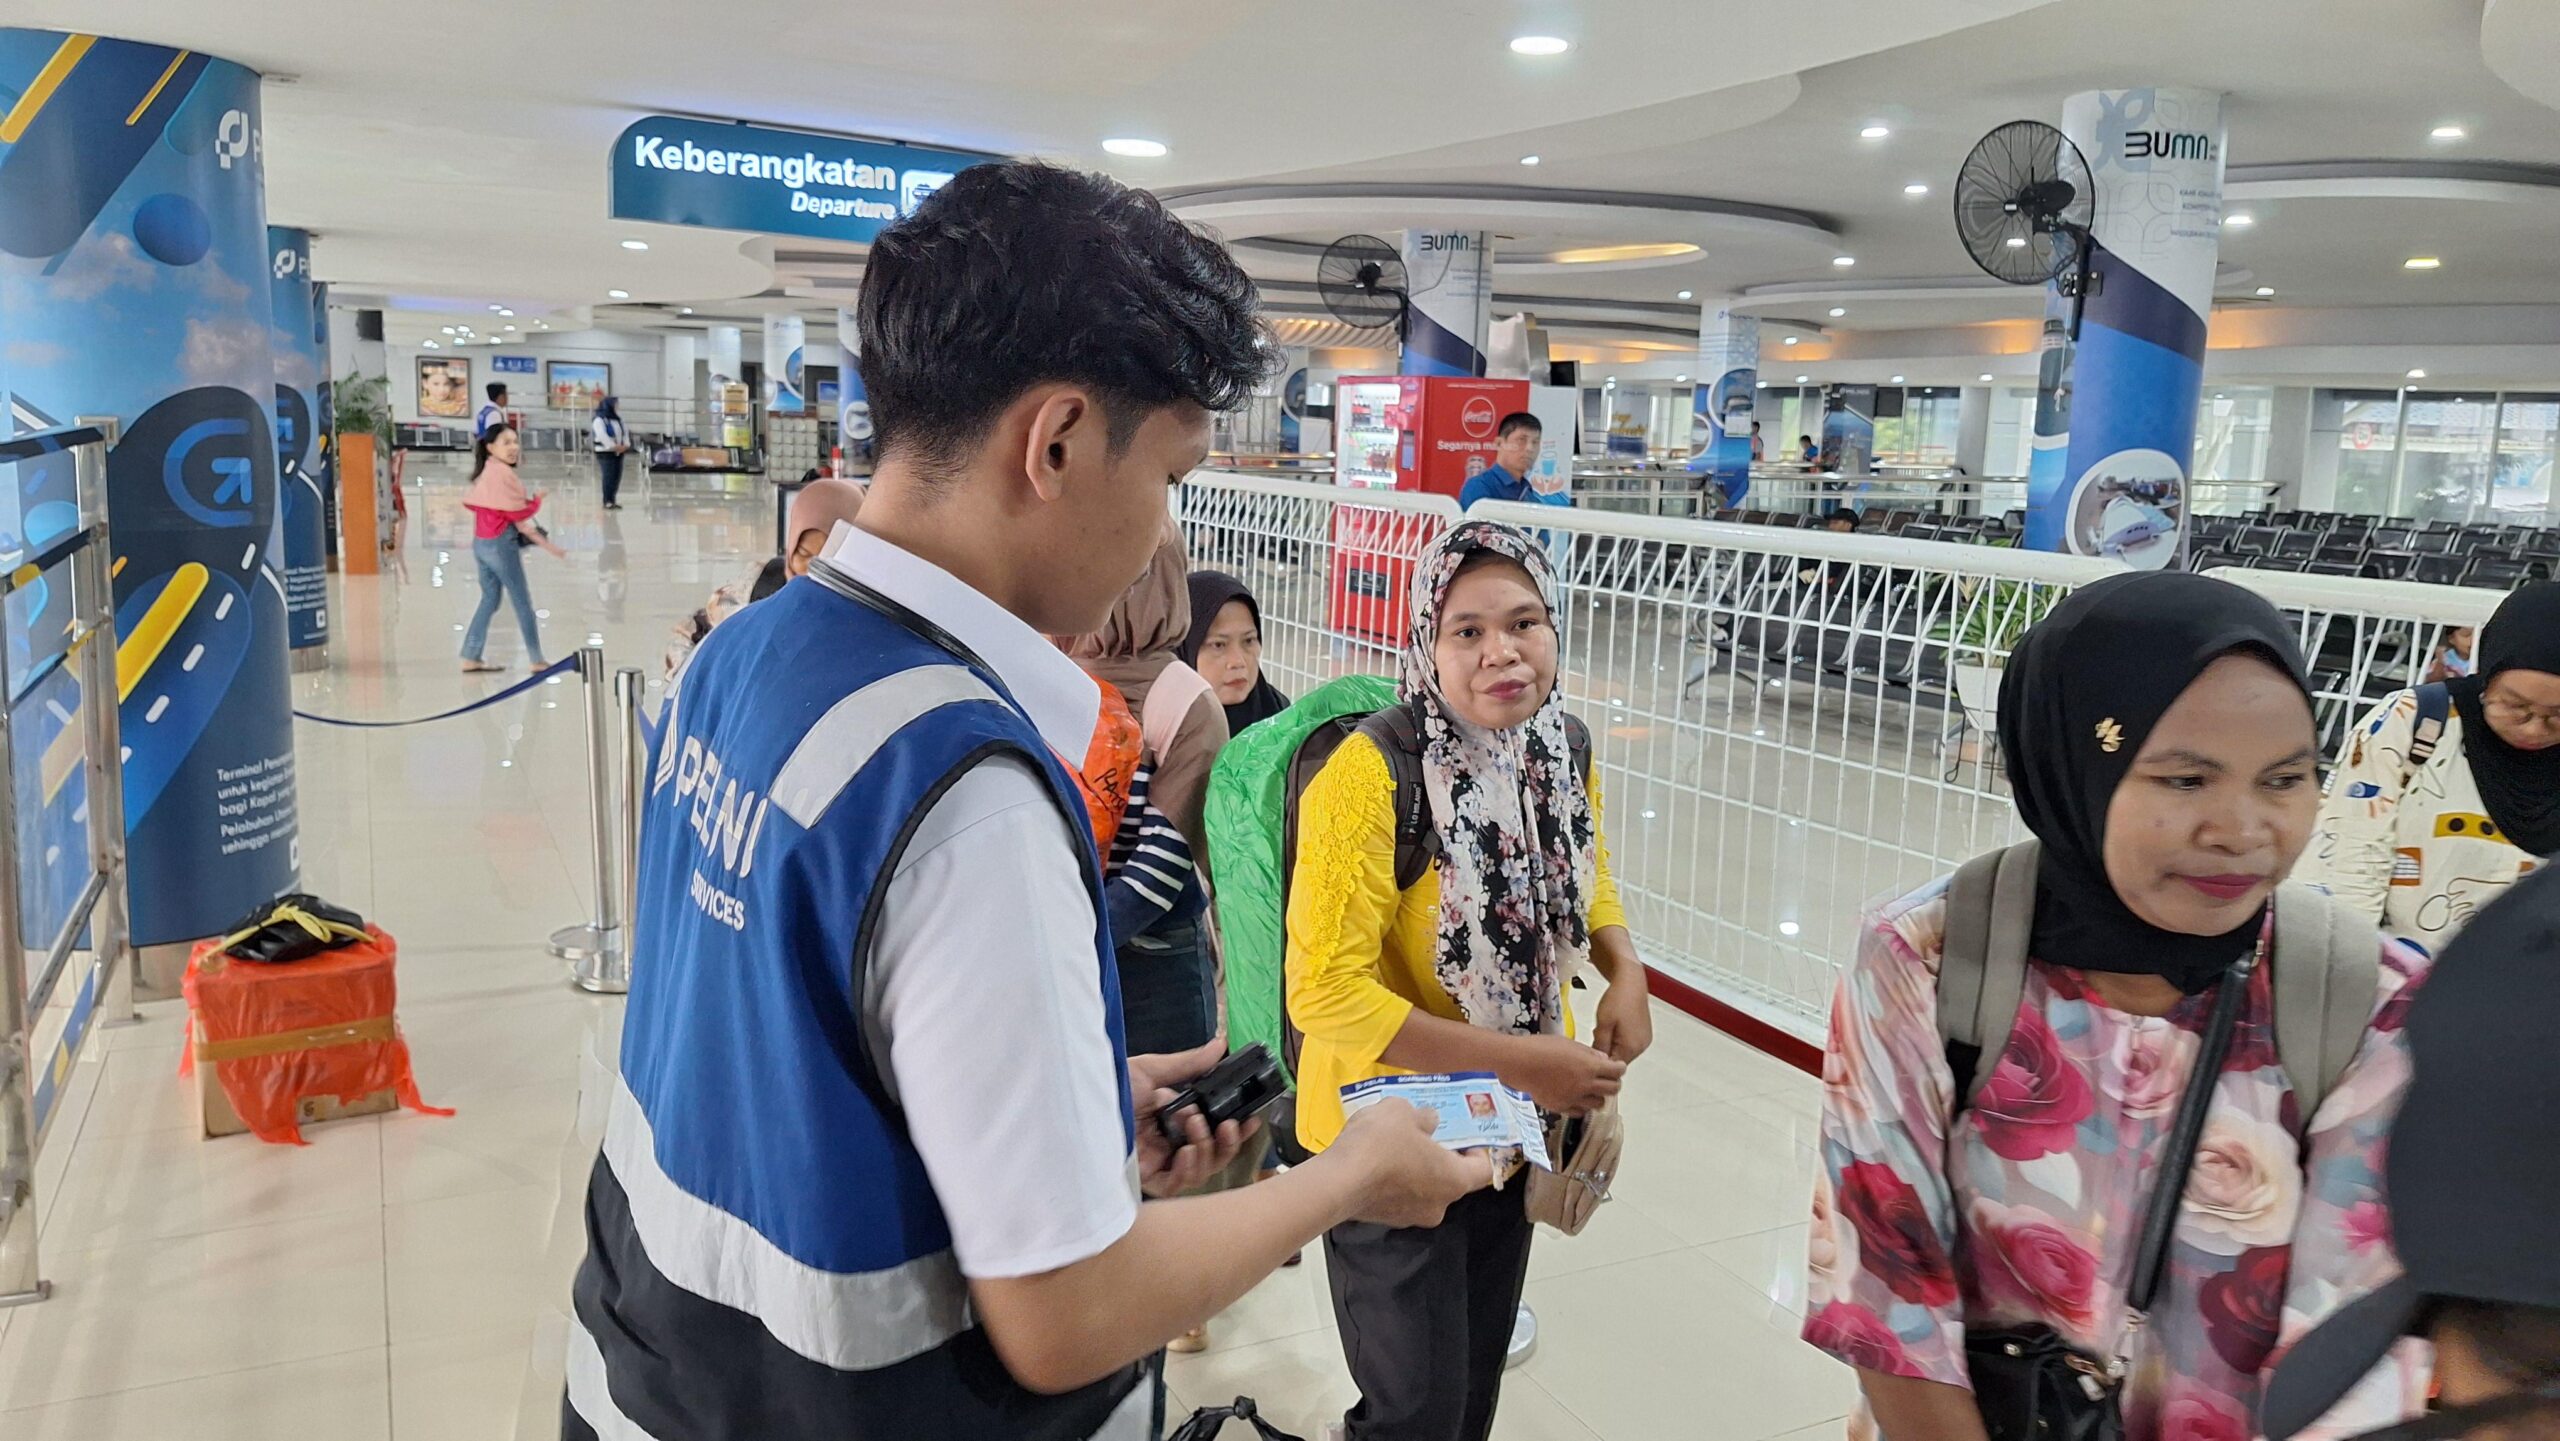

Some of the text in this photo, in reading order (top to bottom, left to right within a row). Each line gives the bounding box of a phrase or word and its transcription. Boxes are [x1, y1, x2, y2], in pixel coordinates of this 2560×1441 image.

[634, 135, 896, 190] Keberangkatan
[790, 190, 896, 221] Departure
[1436, 440, 1481, 453] Segarnya
[217, 761, 262, 782] Terminal
[218, 782, 248, 800] untuk
[219, 799, 248, 816] bagi
[673, 735, 768, 878] PELNI
[220, 815, 274, 838] Pelabuhan
